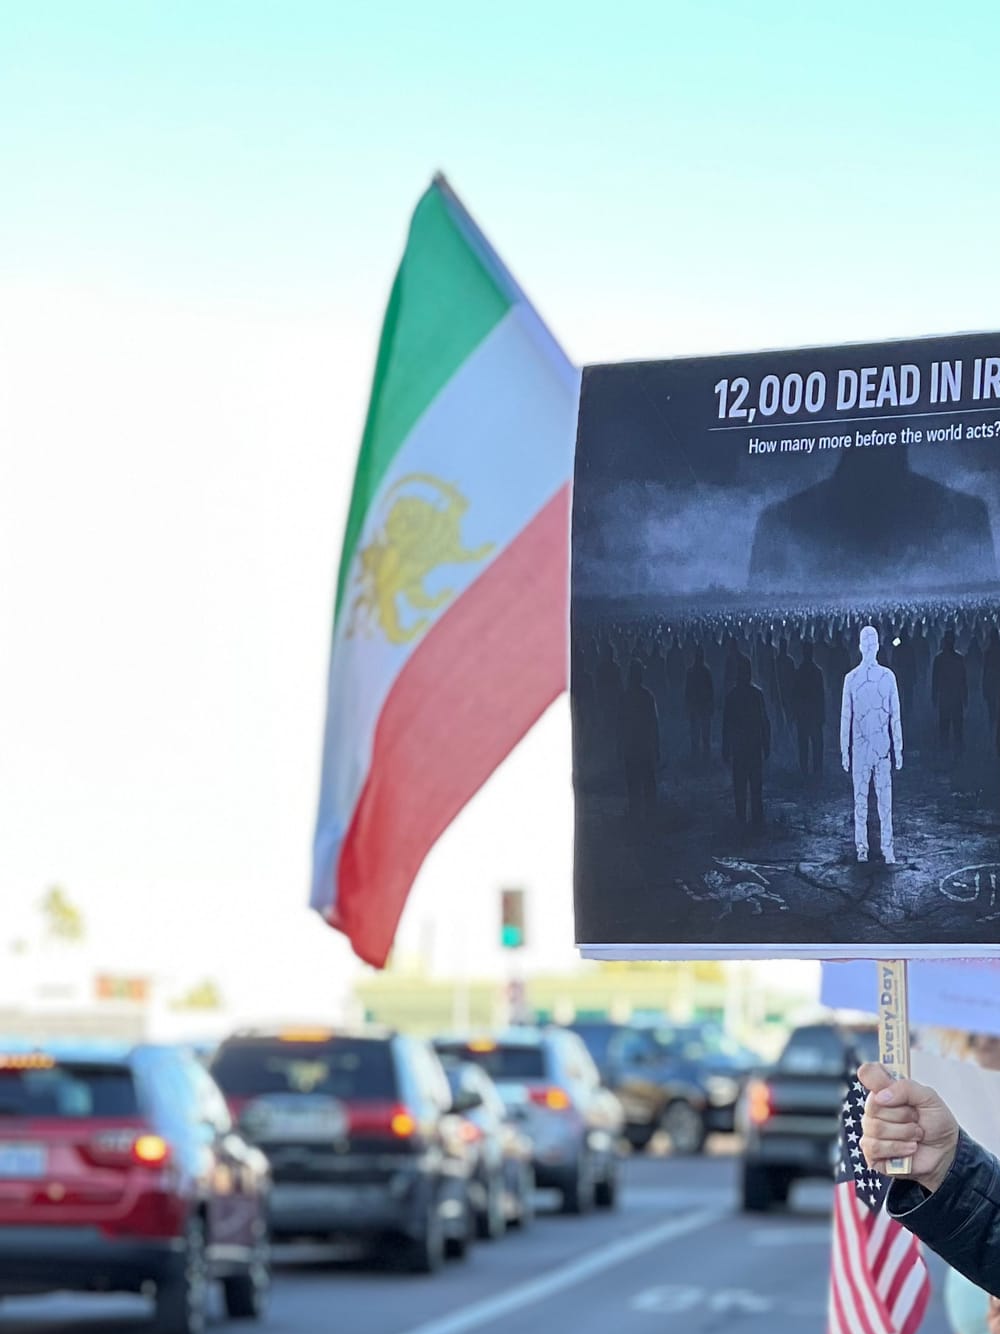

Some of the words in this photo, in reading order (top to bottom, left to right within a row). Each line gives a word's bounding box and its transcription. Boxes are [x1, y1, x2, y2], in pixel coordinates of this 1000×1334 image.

[713, 371, 827, 424] 12,000
[835, 364, 921, 411] DEAD
[929, 360, 963, 404] IN
[748, 437, 778, 454] How
[780, 433, 816, 453] many
[818, 433, 853, 449] more
[855, 427, 897, 447] before
[900, 428, 923, 444] the
[926, 424, 963, 442] world
[880, 966, 896, 1005] Day
[882, 1010, 897, 1064] Every
